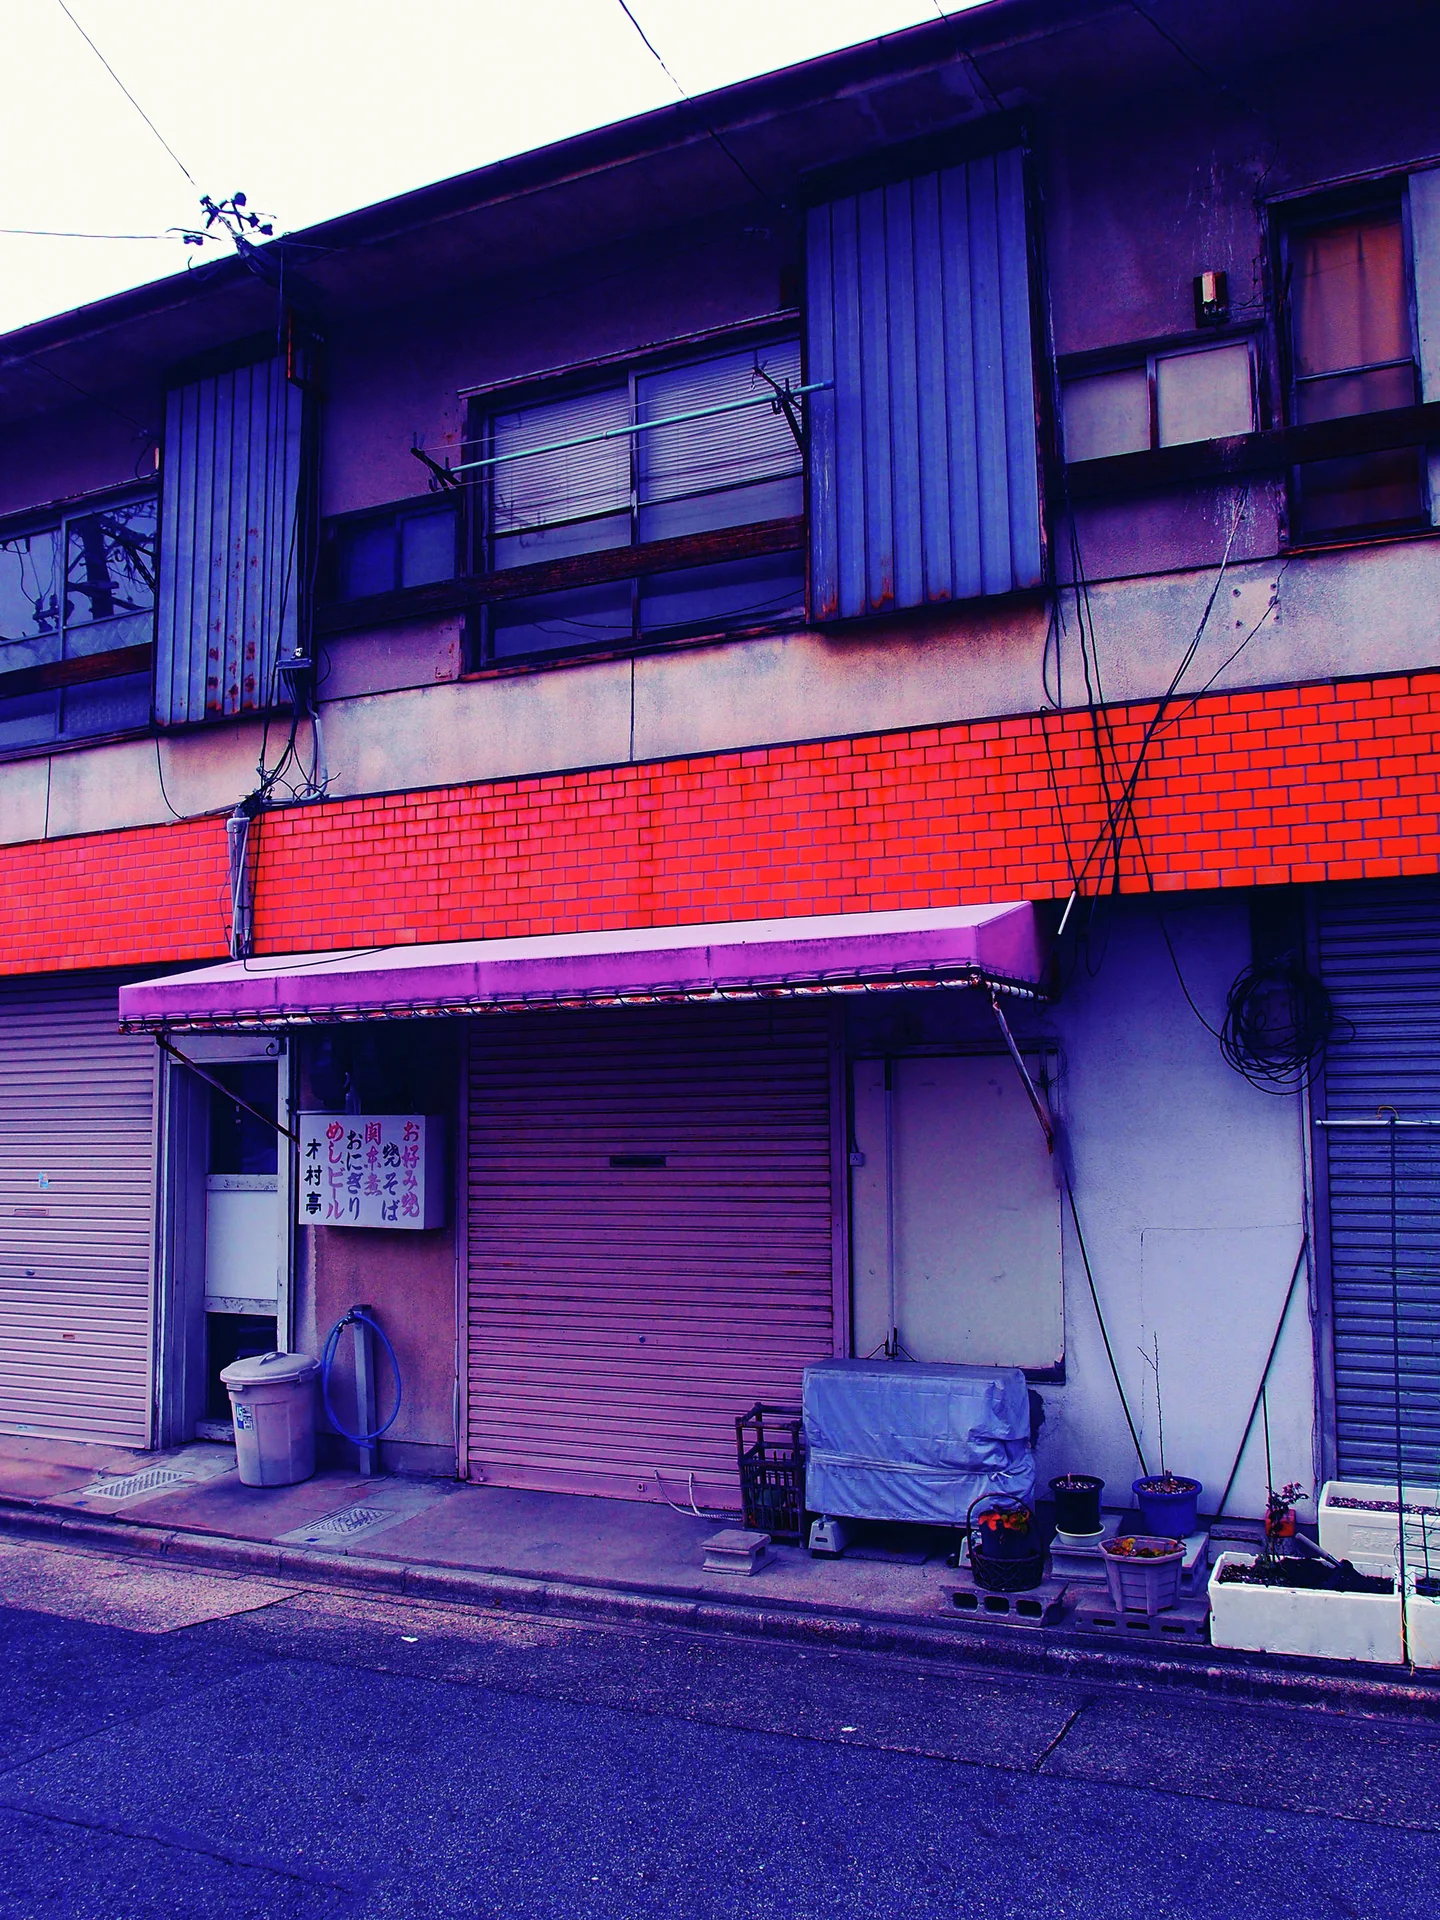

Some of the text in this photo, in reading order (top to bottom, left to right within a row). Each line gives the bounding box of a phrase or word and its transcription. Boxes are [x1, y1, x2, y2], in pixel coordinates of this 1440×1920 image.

[304, 1139, 322, 1215] 木村亭
[347, 1130, 363, 1221] おにぎり
[364, 1122, 382, 1196] 関東煮
